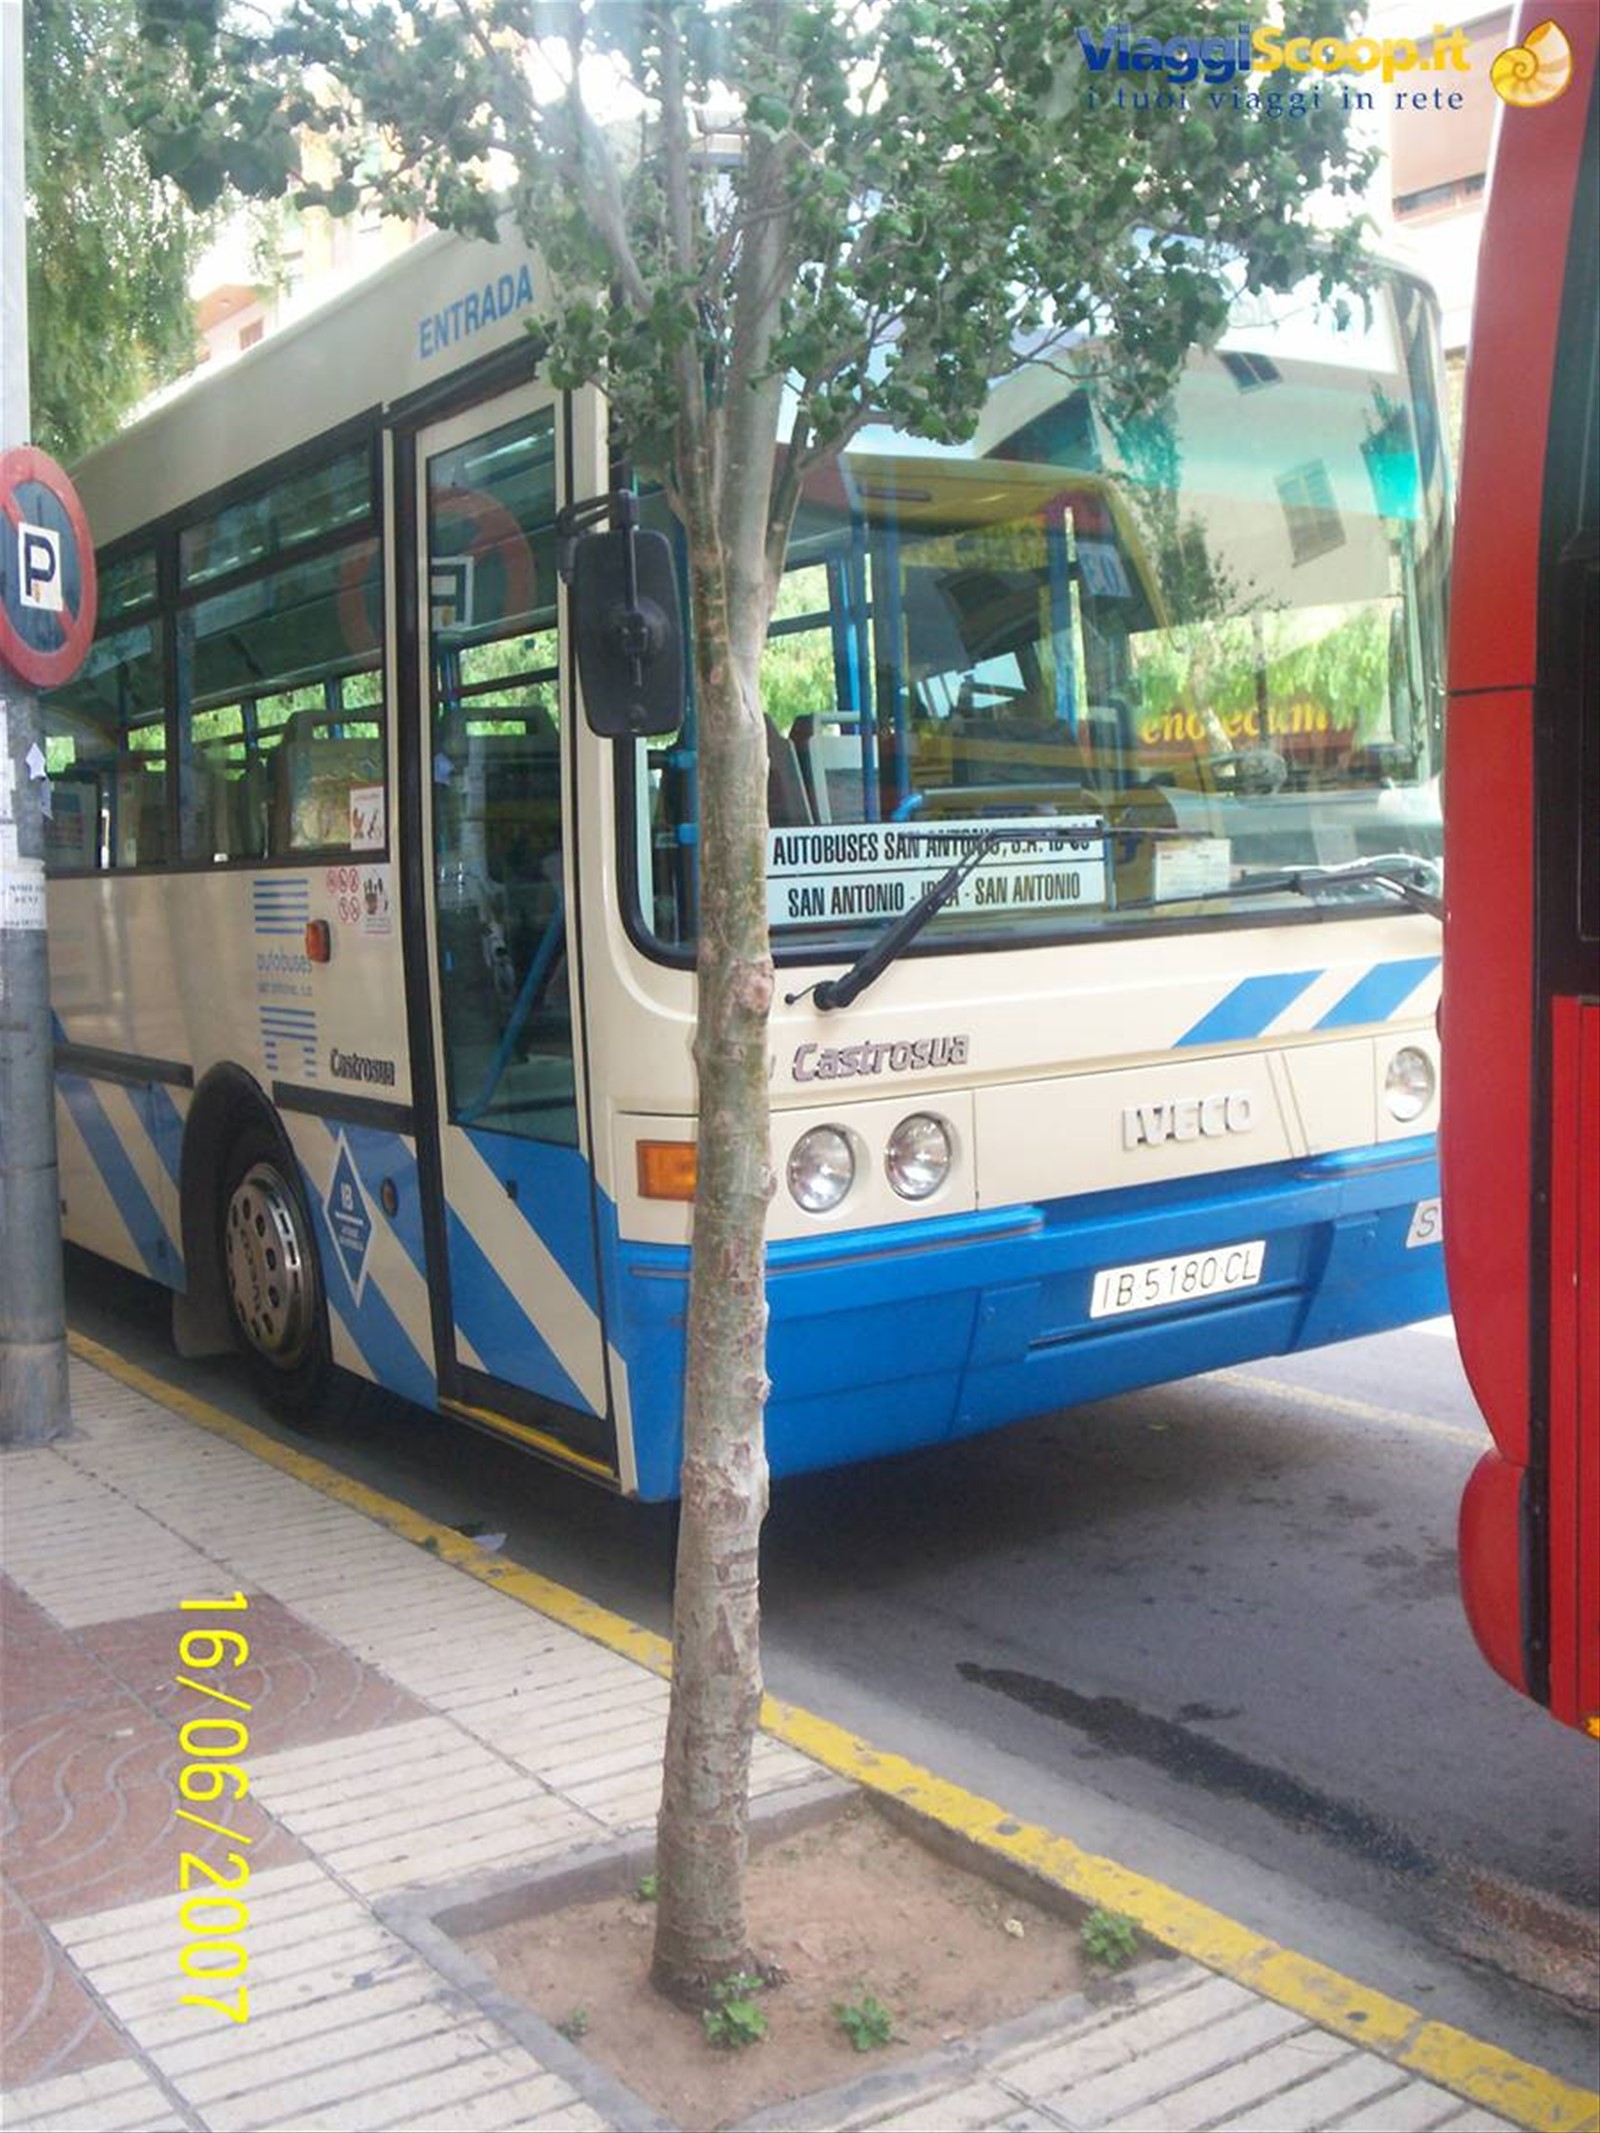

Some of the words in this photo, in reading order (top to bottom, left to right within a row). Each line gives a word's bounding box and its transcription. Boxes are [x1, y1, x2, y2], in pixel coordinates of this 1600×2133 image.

[419, 263, 534, 359] ENTRADA
[24, 531, 56, 598] P
[772, 832, 879, 866] AUTOBUSES
[884, 830, 920, 861] SAN
[787, 885, 825, 919] SAN
[830, 882, 905, 915] ANTONIO
[974, 876, 1008, 906] SAN
[1012, 872, 1081, 905] ANTONIO
[330, 1047, 395, 1087] Castrosua
[792, 1034, 971, 1082] Castrosua
[1121, 1089, 1258, 1152] IVECO
